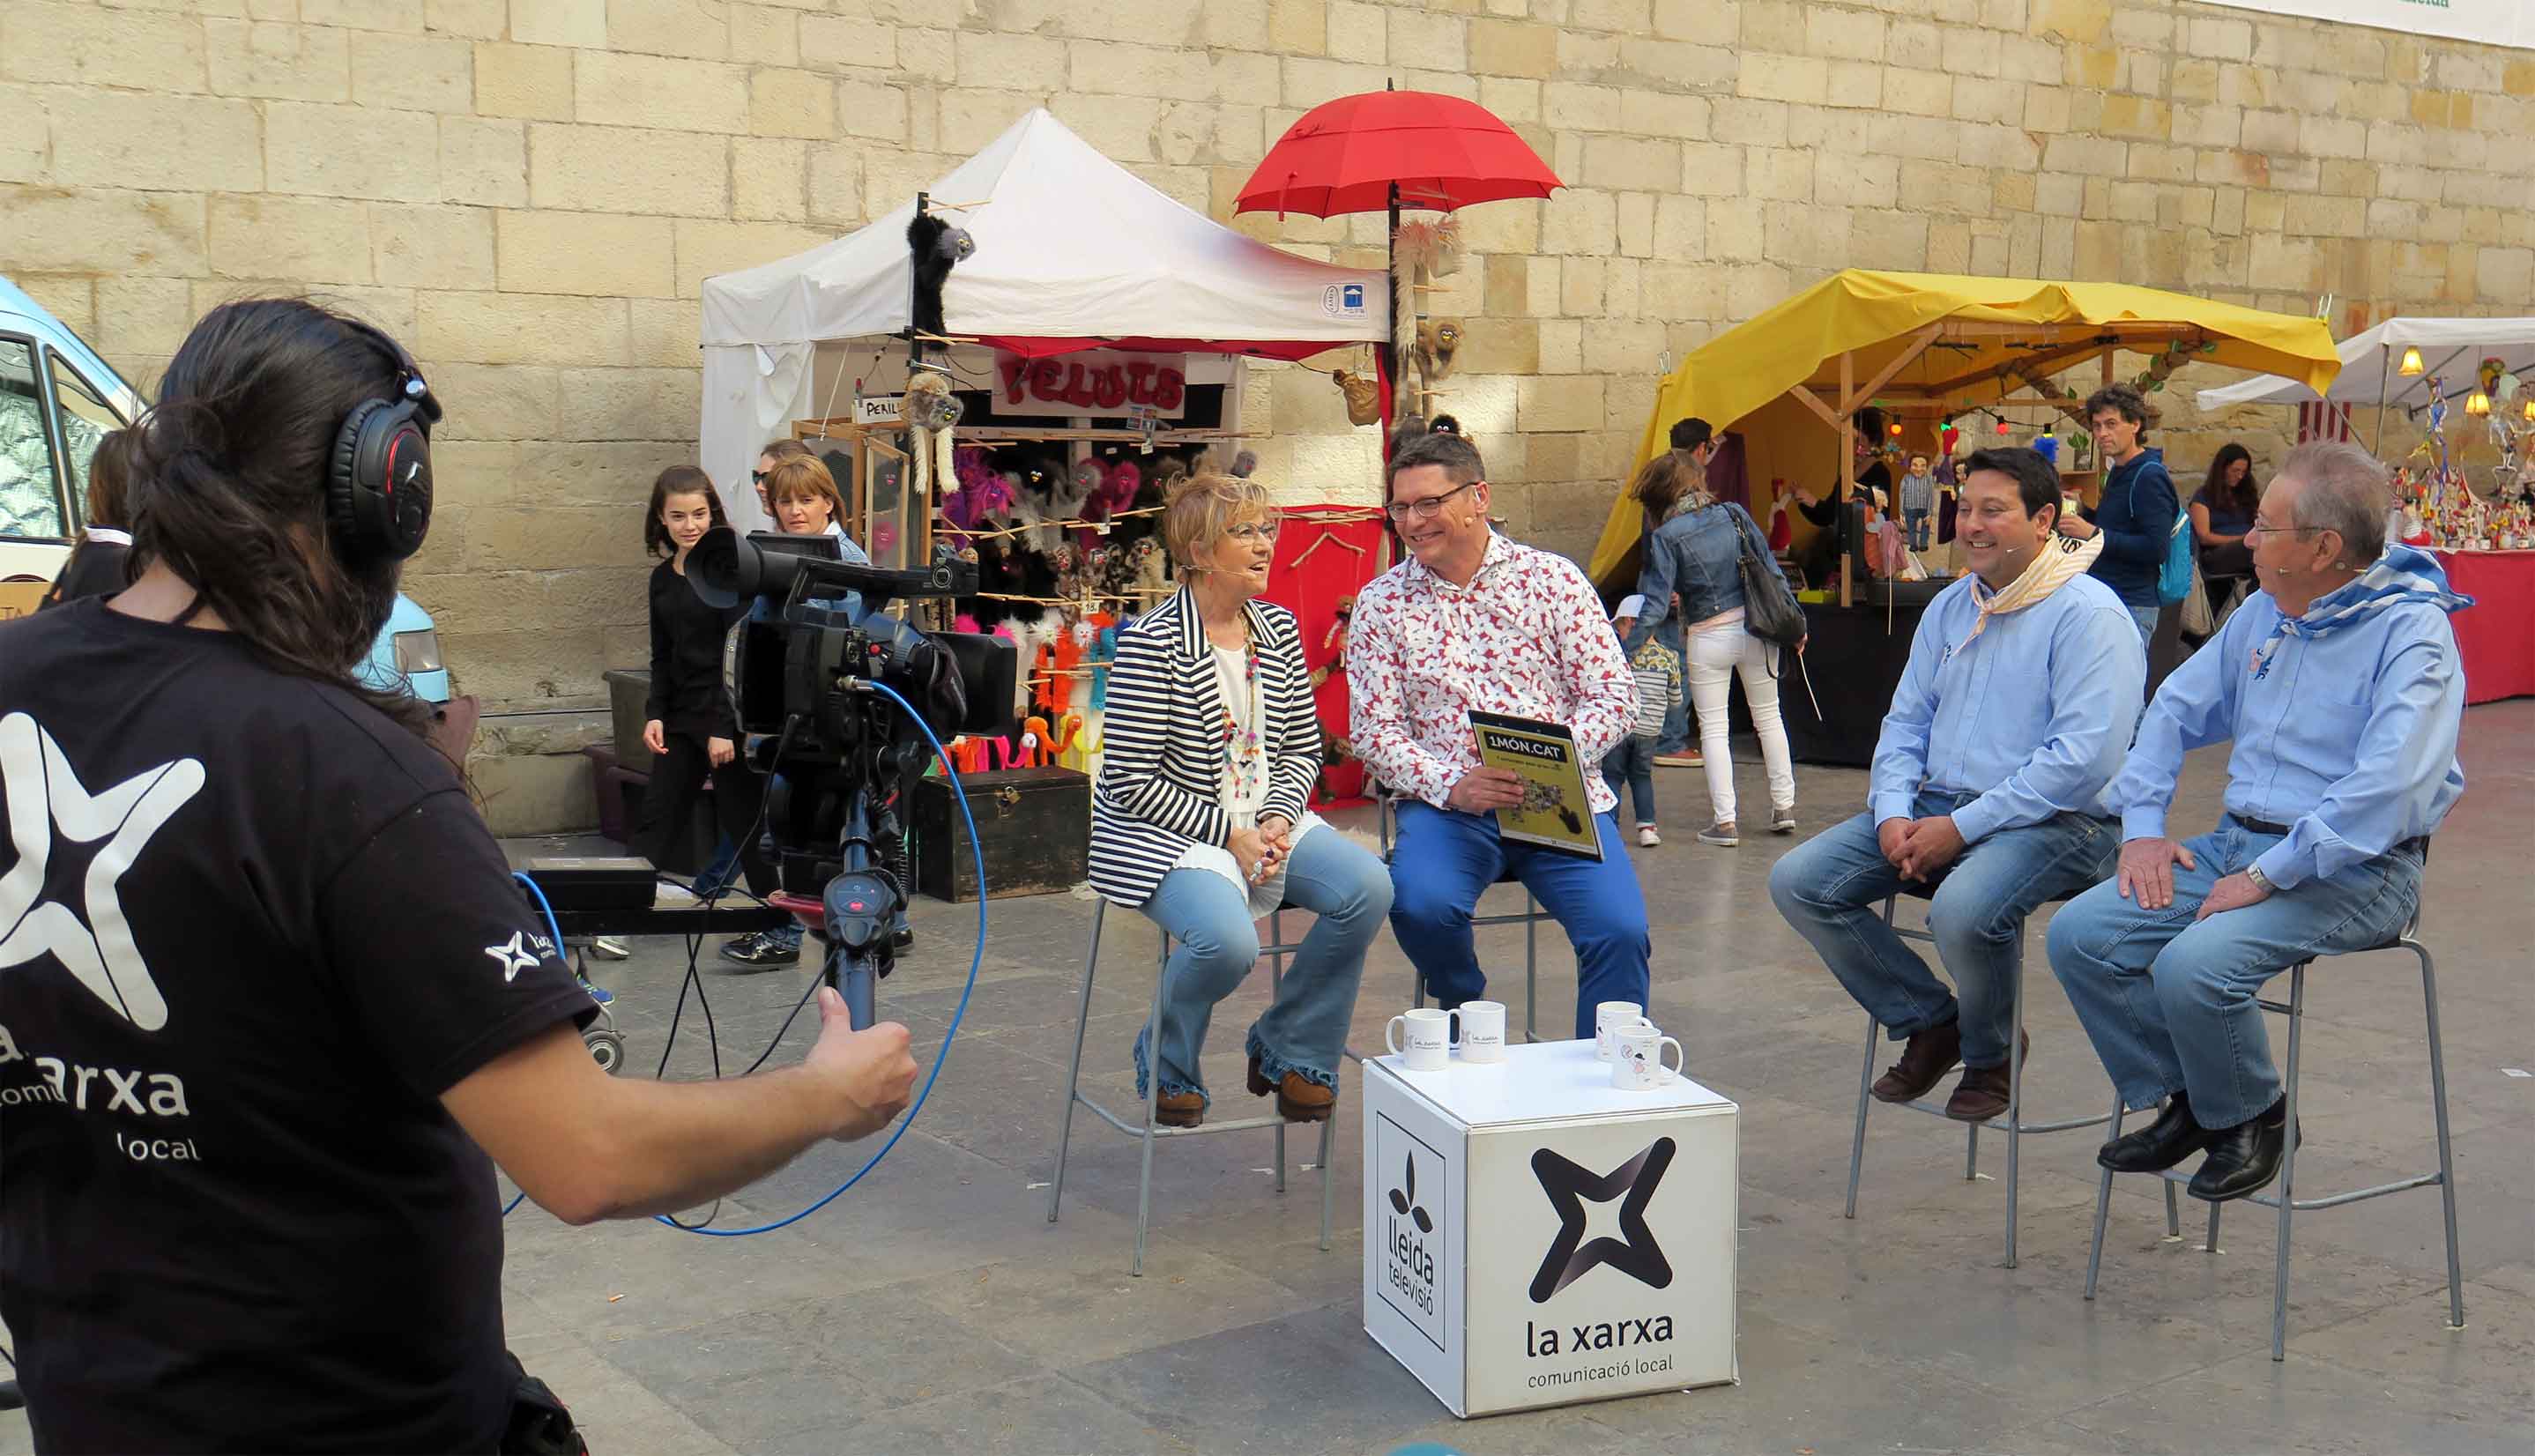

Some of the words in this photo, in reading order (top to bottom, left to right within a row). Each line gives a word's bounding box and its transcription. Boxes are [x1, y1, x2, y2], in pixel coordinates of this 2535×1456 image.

[866, 402, 903, 416] PERIL
[1490, 736, 1560, 759] 1MÓN.CAT
[35, 1057, 190, 1116] arxa
[1389, 1215, 1433, 1287] lleida
[1388, 1262, 1433, 1317] televisió
[1527, 1320, 1558, 1357] la
[1572, 1314, 1673, 1352] xarxa
[1528, 1362, 1631, 1388] comunicació
[1635, 1355, 1673, 1380] local
